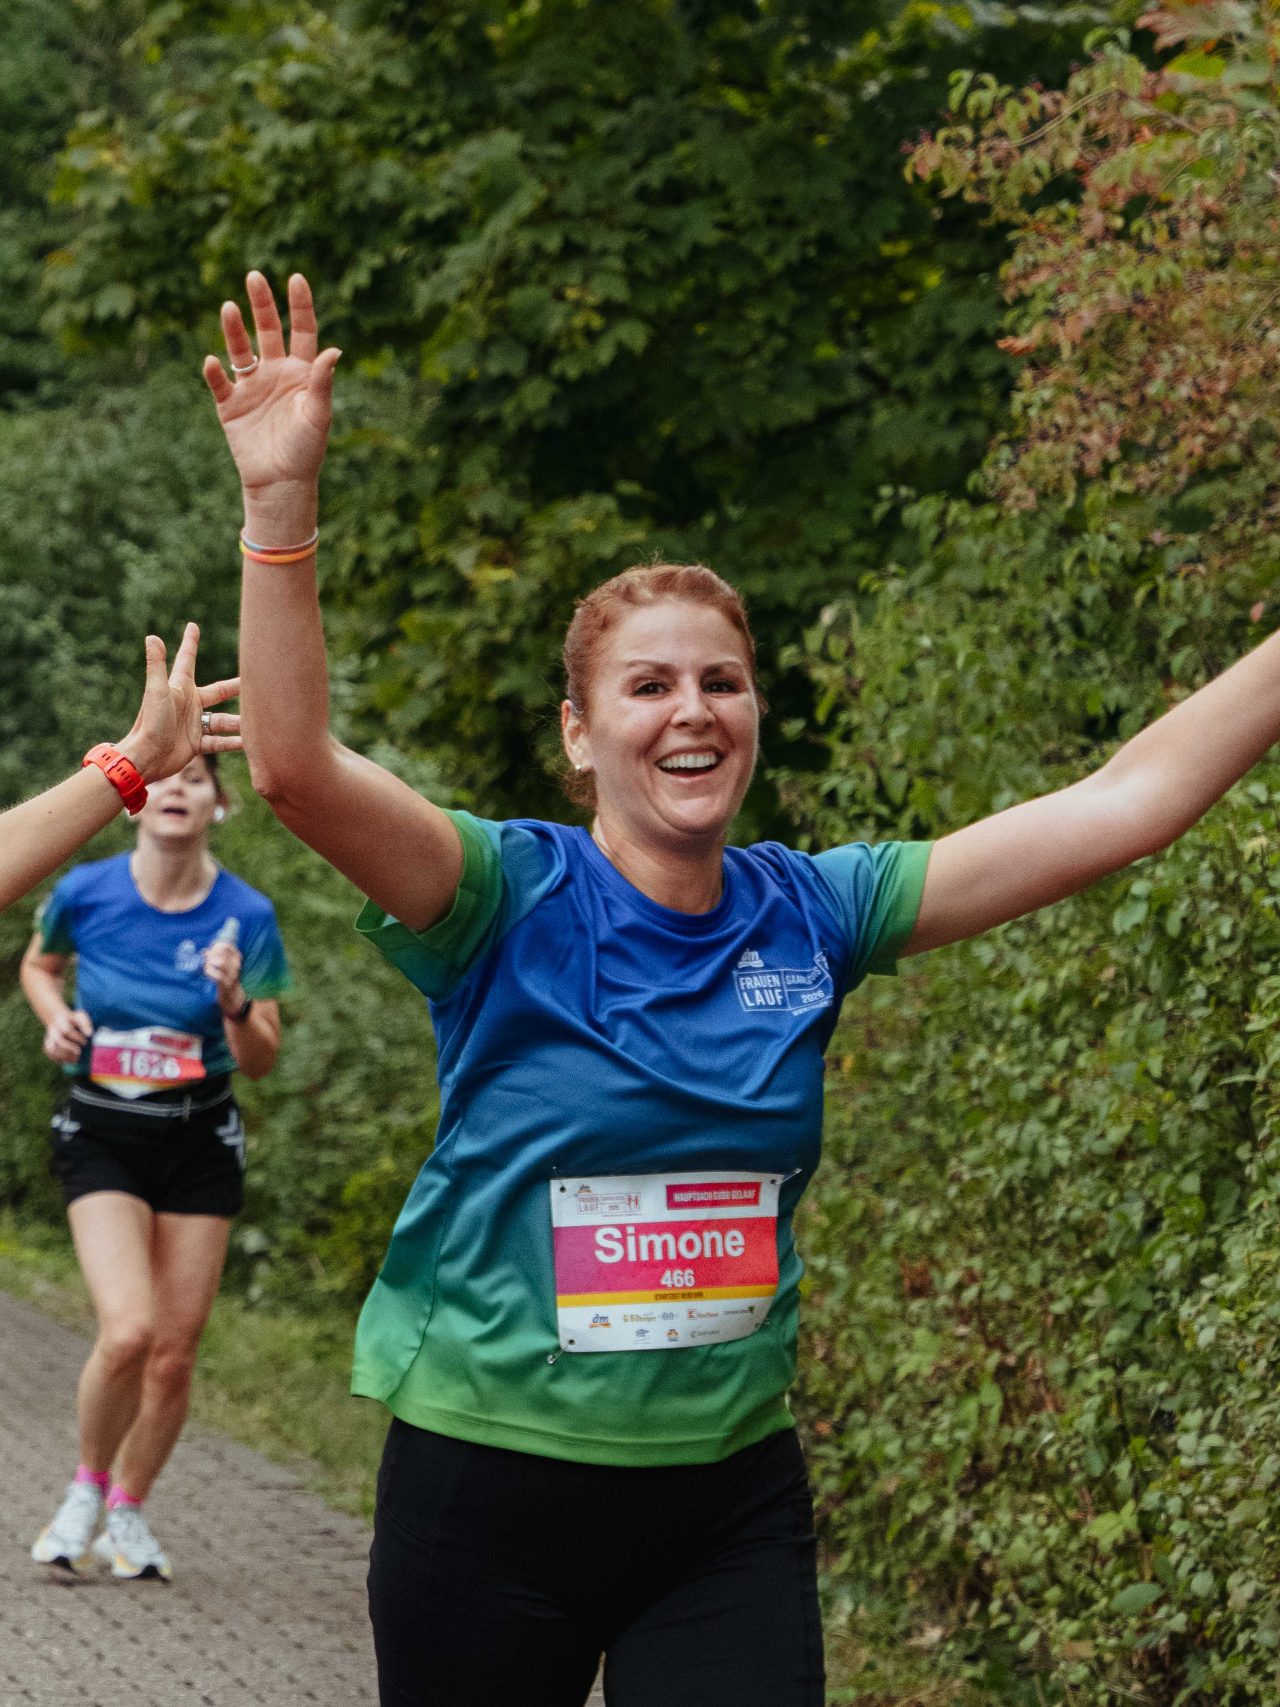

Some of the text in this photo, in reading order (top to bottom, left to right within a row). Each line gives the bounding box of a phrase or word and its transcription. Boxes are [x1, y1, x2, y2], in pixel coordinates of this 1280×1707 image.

[739, 975, 781, 990] FRAUEN
[742, 989, 783, 1006] LAUF
[594, 1226, 745, 1263] Simone
[660, 1269, 695, 1288] 466
[592, 1313, 609, 1324] dm
